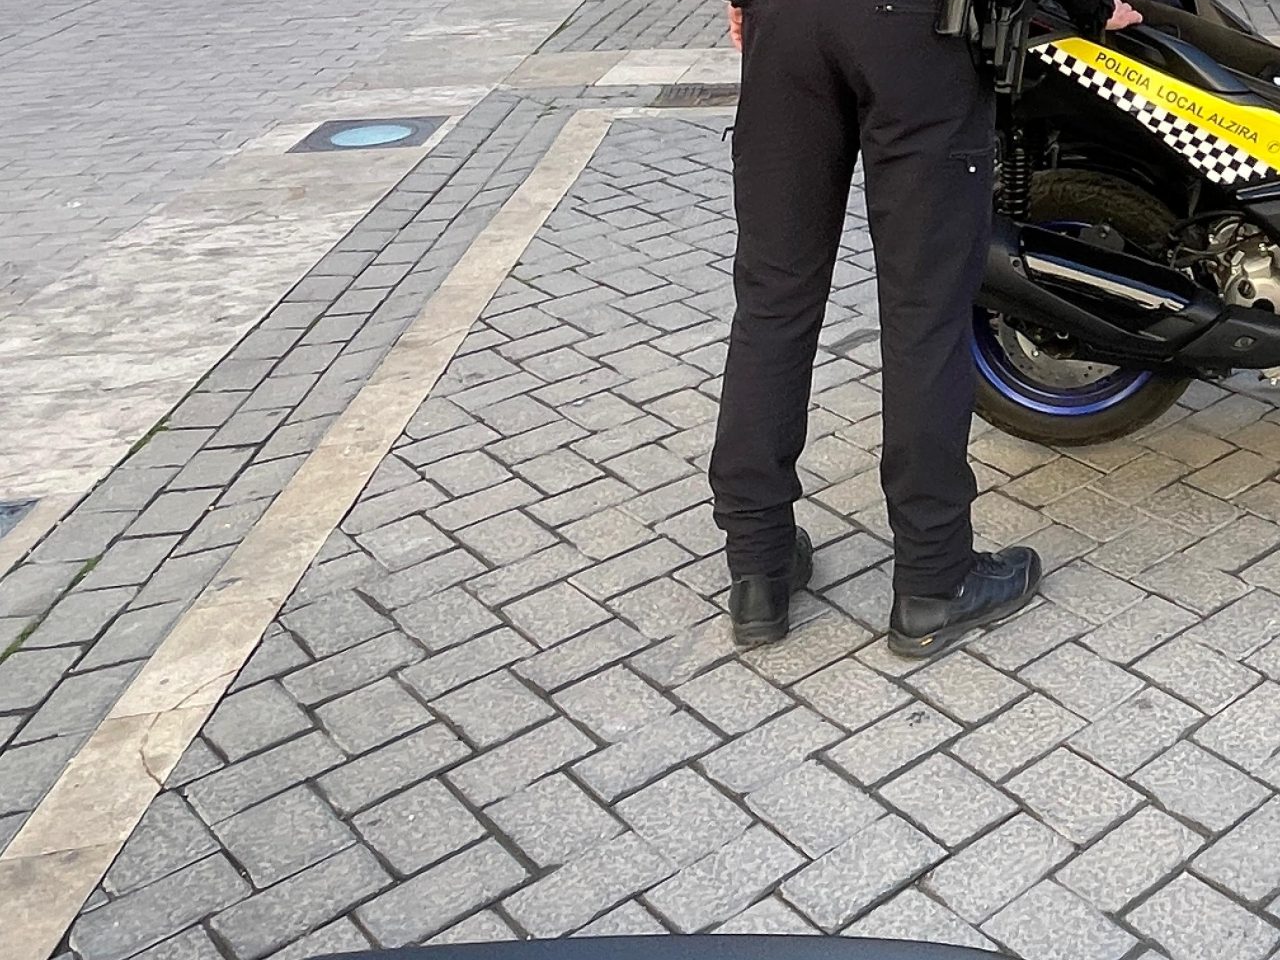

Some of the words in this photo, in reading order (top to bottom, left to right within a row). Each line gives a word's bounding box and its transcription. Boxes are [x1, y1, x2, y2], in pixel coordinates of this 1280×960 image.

[1095, 51, 1152, 91] POLICIA
[1157, 84, 1205, 120] LOCAL
[1207, 112, 1259, 144] ALZIRA
